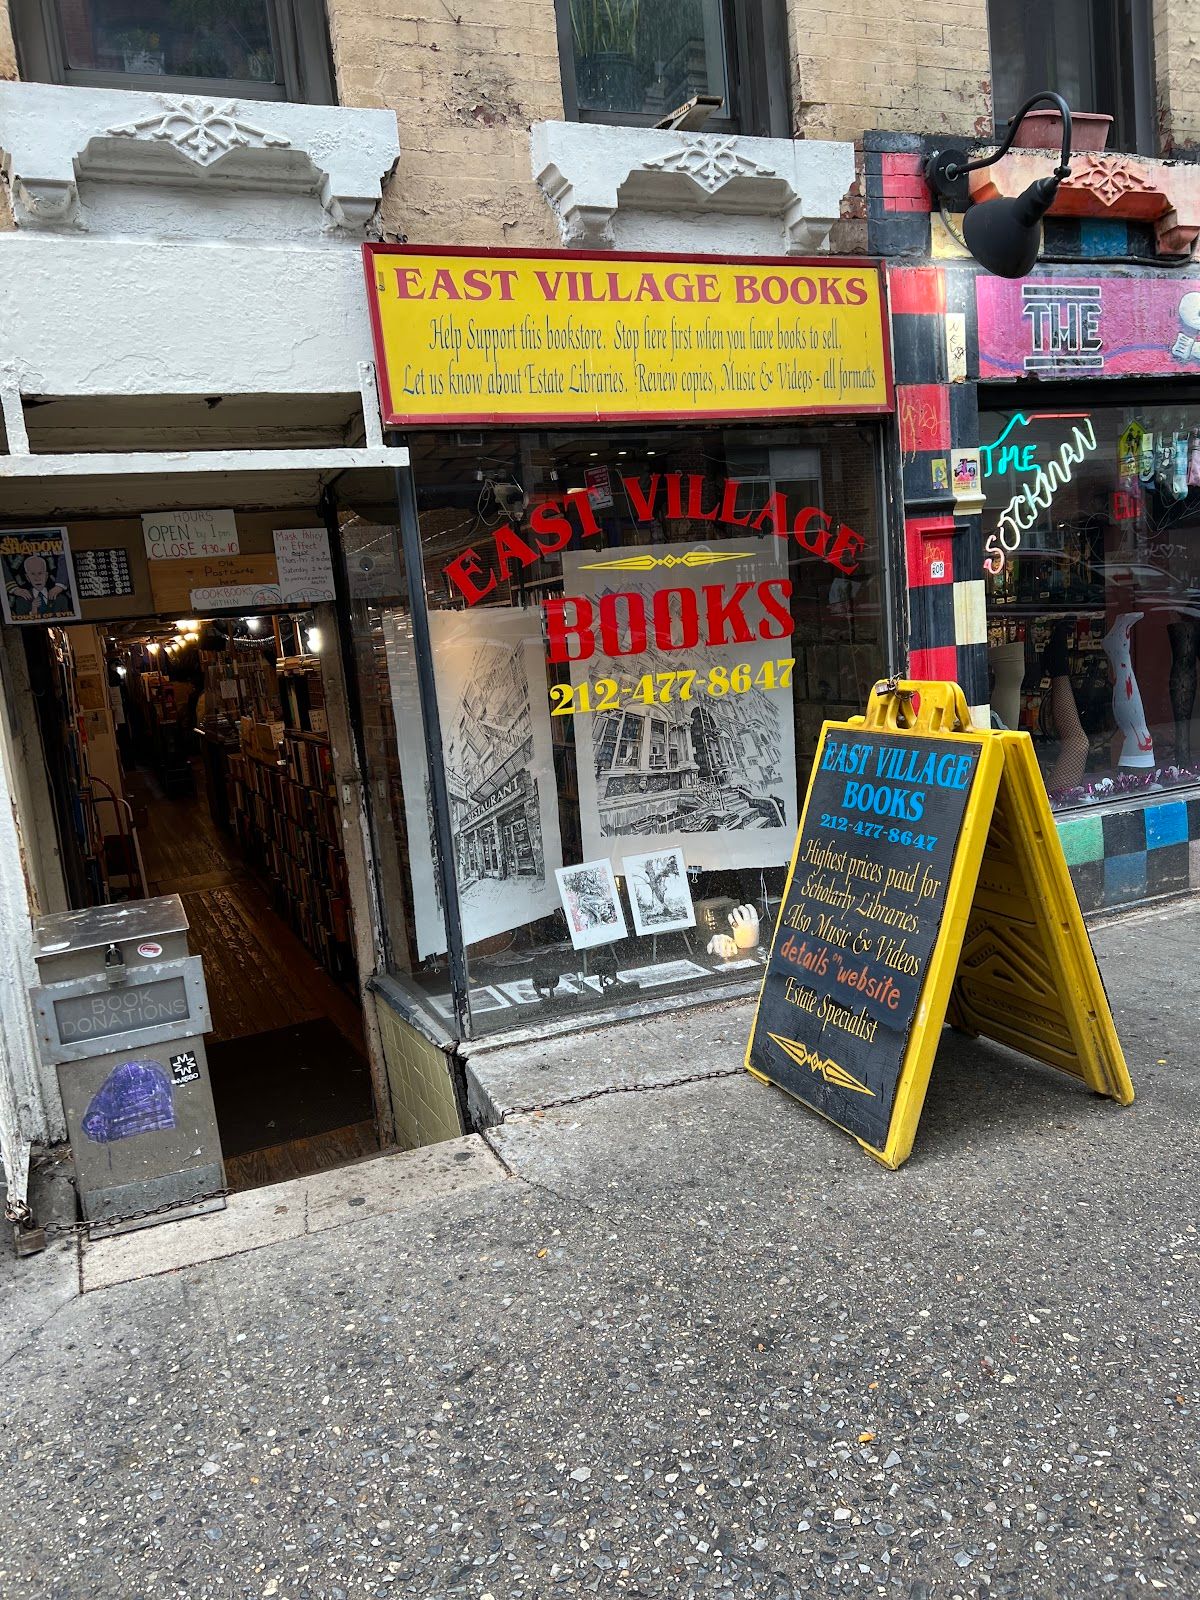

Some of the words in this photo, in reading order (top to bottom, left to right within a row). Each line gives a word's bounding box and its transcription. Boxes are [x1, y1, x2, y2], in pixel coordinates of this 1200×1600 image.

[393, 267, 519, 301] EAST
[533, 270, 721, 304] VILLAGE
[734, 275, 869, 306] BOOKS
[429, 314, 462, 361] Help
[466, 318, 516, 363] Support
[520, 314, 542, 350] this
[546, 314, 606, 350] bookstore.
[613, 319, 640, 361] Stop
[643, 315, 667, 350] here
[670, 316, 692, 362] first
[696, 316, 724, 350] when
[726, 329, 746, 361] you
[749, 316, 774, 350] have
[777, 316, 806, 350] books
[809, 324, 819, 350] to
[822, 317, 842, 350] sell.
[402, 364, 424, 396] Let
[428, 372, 444, 395] us
[449, 359, 483, 395] know
[487, 361, 522, 395] about
[524, 363, 564, 394] Estate
[568, 359, 628, 394] Libraries.
[635, 363, 678, 393] Review
[681, 364, 717, 403] copies,
[720, 360, 756, 393] Music
[759, 362, 774, 391] &
[777, 363, 813, 391] Videos
[823, 358, 836, 390] all
[838, 358, 876, 400] formats
[979, 444, 1037, 478] THE
[173, 510, 214, 523] HOURS
[1113, 491, 1142, 521] EXI
[148, 523, 190, 542] OPEN
[151, 542, 197, 558] CLOSE
[443, 486, 603, 606] EAST
[623, 473, 866, 575] VILLAGE
[194, 587, 253, 600] COOKBOOKS
[11, 613, 41, 621] TOUCH
[541, 578, 796, 664] BOOKS
[549, 658, 796, 716] 212-477-8647
[821, 741, 873, 777] EAST
[875, 746, 973, 790] VILLAGE
[467, 775, 520, 822] RESTAURANT
[841, 780, 926, 822] BOOKS
[819, 813, 939, 852] 212-477-8647
[801, 838, 848, 876] Highest
[845, 854, 884, 885] prices
[883, 862, 919, 896] paid
[914, 864, 941, 906] for
[800, 873, 856, 920] Scholarly
[784, 903, 812, 932] Also
[811, 912, 853, 949] Music
[852, 928, 873, 955] &
[875, 935, 922, 977] Videos
[780, 933, 829, 977] details
[837, 964, 901, 1010] website
[61, 1000, 187, 1037] DONATIONS
[91, 990, 153, 1015] BOOK
[784, 976, 818, 1012] Estate
[817, 993, 879, 1043] Specialist
